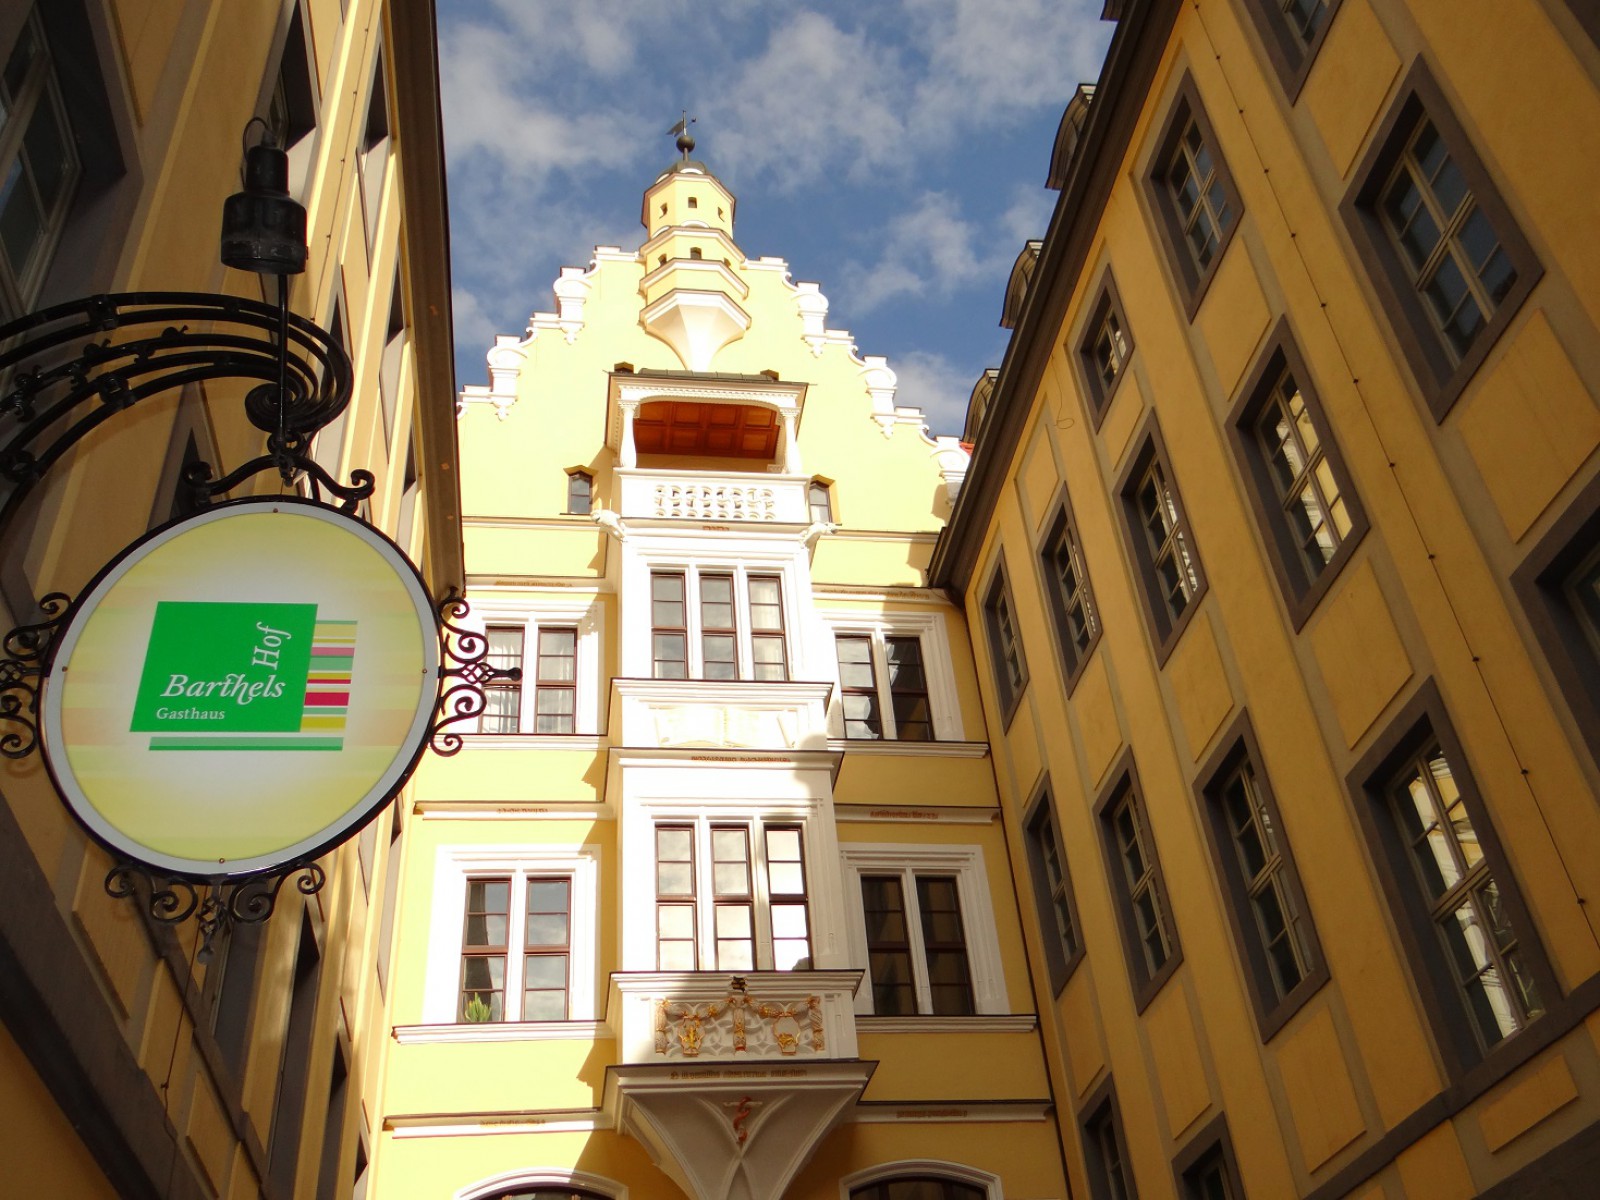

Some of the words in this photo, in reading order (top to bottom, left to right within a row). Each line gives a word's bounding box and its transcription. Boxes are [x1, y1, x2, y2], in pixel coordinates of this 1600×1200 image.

[252, 621, 292, 670] Hof
[160, 673, 286, 705] Barthels
[156, 707, 225, 720] Gasthaus
